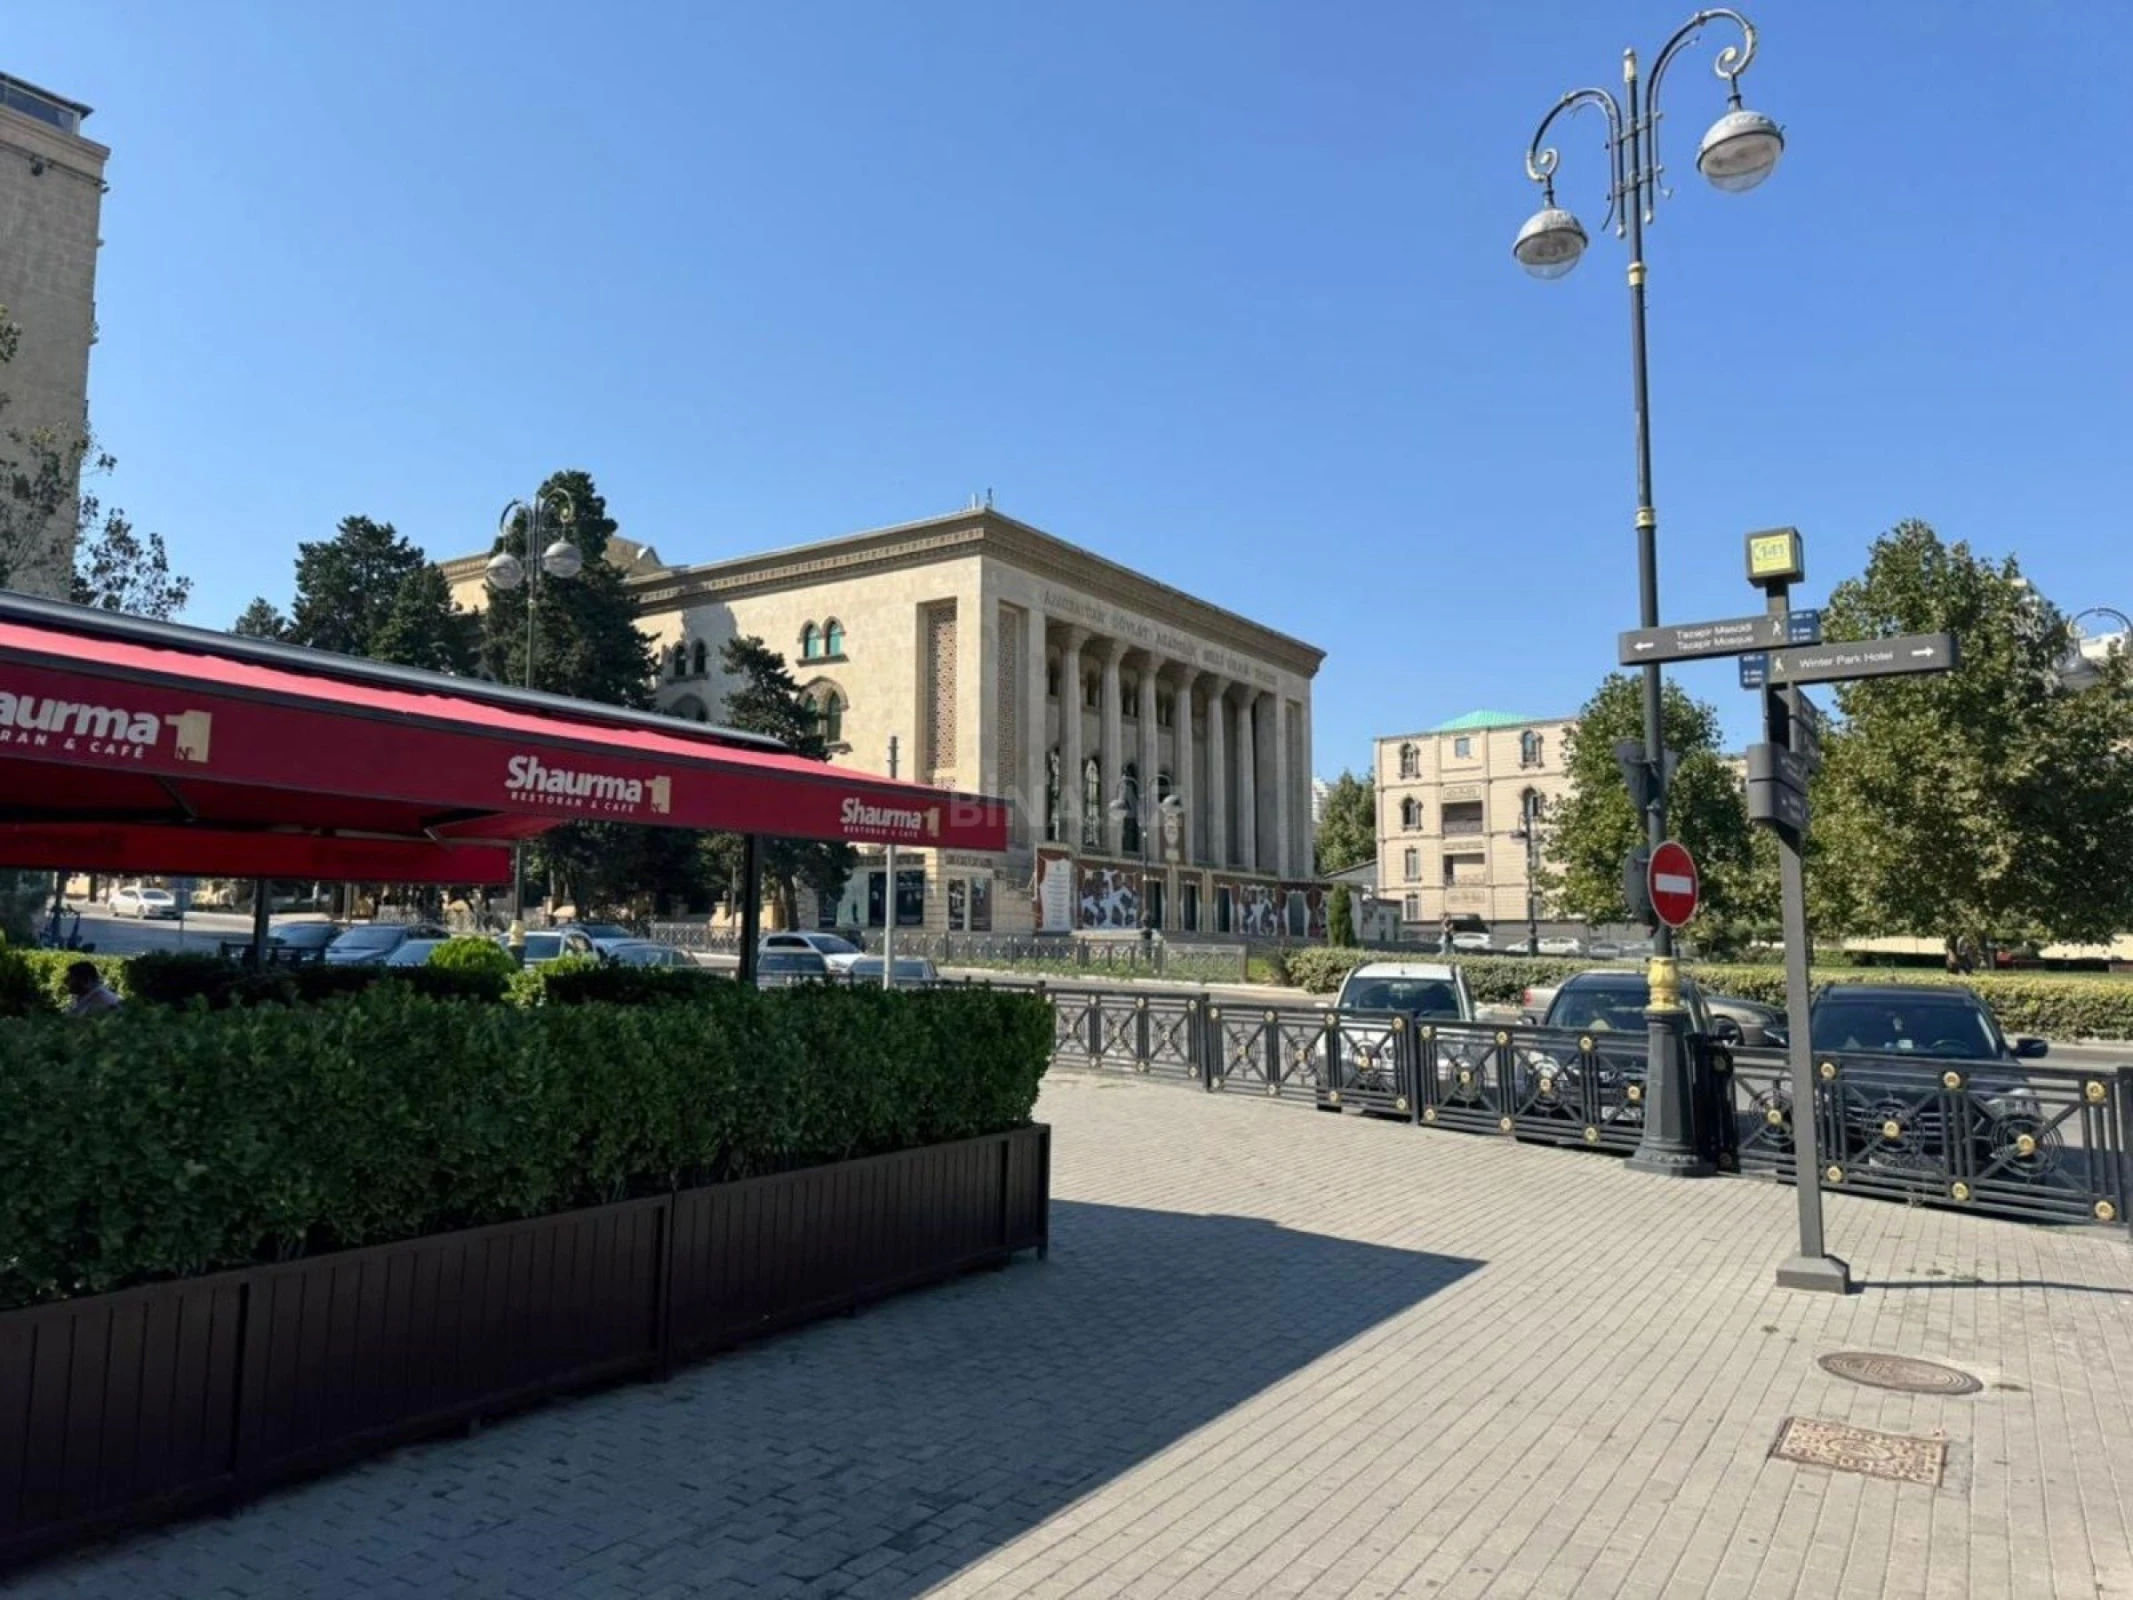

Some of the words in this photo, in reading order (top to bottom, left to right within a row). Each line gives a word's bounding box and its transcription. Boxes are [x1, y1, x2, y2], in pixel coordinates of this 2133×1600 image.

[1799, 657, 1833, 668] Winter
[1836, 654, 1861, 665] Park
[1864, 651, 1894, 662] Hotel
[64, 738, 76, 750] &
[504, 755, 641, 803] Shaurma
[645, 775, 672, 814] 1
[512, 793, 582, 807] RESTORAN
[840, 797, 922, 830] Shaurma
